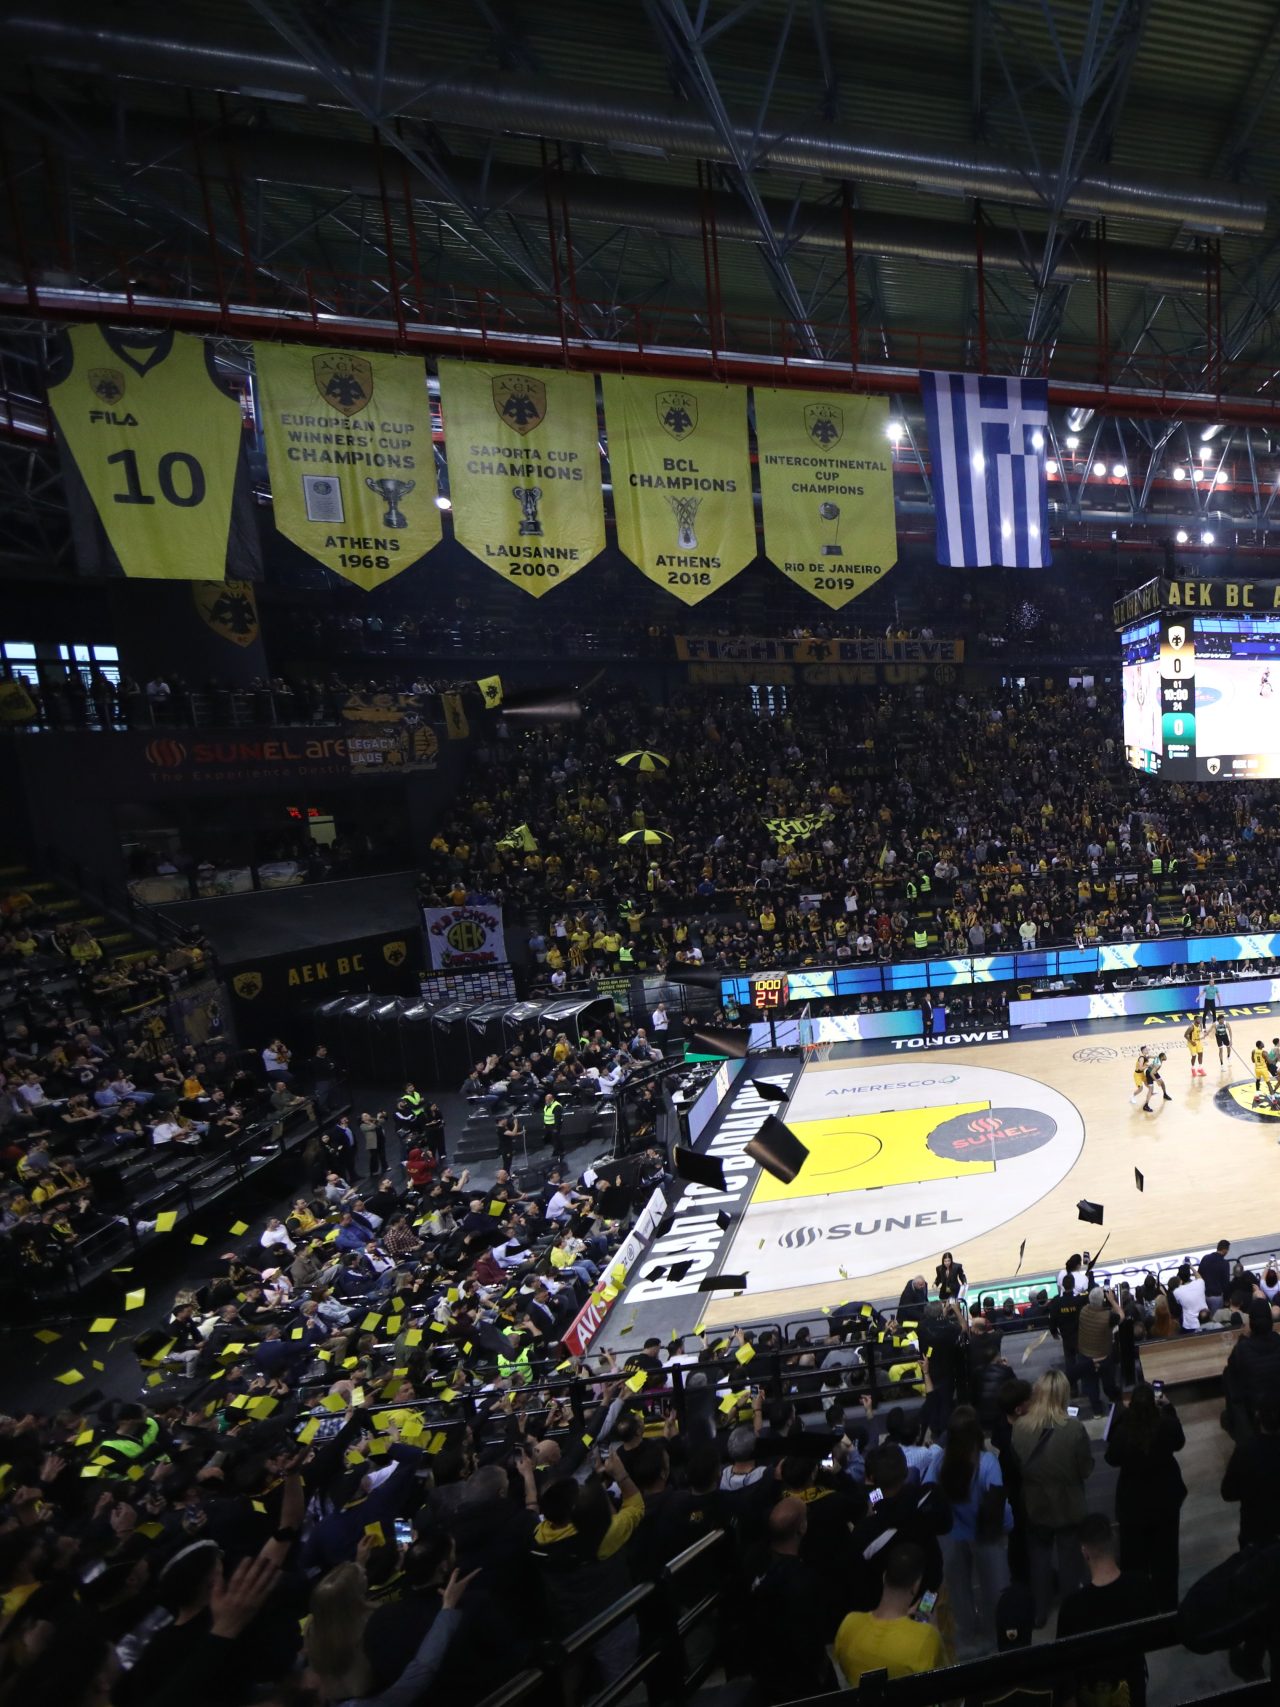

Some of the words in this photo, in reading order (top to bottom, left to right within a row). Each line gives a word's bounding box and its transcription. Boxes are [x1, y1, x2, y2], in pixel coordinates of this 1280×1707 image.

[89, 410, 139, 426] FILA
[281, 414, 375, 432] EUROPEAN
[380, 422, 415, 434] CUP
[287, 431, 374, 447] WINNERS'
[379, 438, 411, 450] CUP
[287, 447, 416, 469] CHAMPIONS
[469, 445, 543, 462] SAPORTA
[548, 450, 579, 462] CUP
[467, 460, 584, 481] CHAMPIONS
[662, 457, 699, 473] BCL
[764, 455, 887, 472] INTERCONTINENTAL
[107, 449, 207, 507] 10
[629, 473, 737, 493] CHAMPIONS
[815, 471, 840, 481] CUP
[791, 483, 865, 496] CHAMPIONS
[325, 535, 401, 551] ATHENS
[485, 543, 580, 560] LAUSANNE
[338, 554, 390, 569] 1968
[509, 562, 560, 577] 2000
[656, 554, 722, 570] ATHENS
[784, 562, 805, 572] RIO
[809, 563, 824, 573] DE
[828, 563, 882, 575] JANEIRO
[667, 572, 712, 586] 2018
[814, 577, 854, 590] 2019
[1168, 582, 1212, 606] AEK
[1226, 584, 1254, 607] BC
[839, 641, 956, 661] BELIEVE
[1173, 658, 1182, 673] 0
[1173, 718, 1184, 736] 0
[192, 741, 305, 763] SUNEL
[347, 738, 395, 750] LEGACY
[448, 921, 485, 952] AEK
[287, 963, 330, 987] AEK
[336, 954, 366, 976] BC
[755, 979, 781, 991] 10:00
[755, 990, 779, 1006] 24
[890, 1029, 1010, 1051] TONGWEI
[825, 1079, 936, 1096] AMERESCO
[951, 1125, 1039, 1150] SUNEL
[826, 1209, 964, 1241] SUNEL
[623, 1208, 733, 1304] ROAD
[575, 1300, 608, 1350] AVIS
